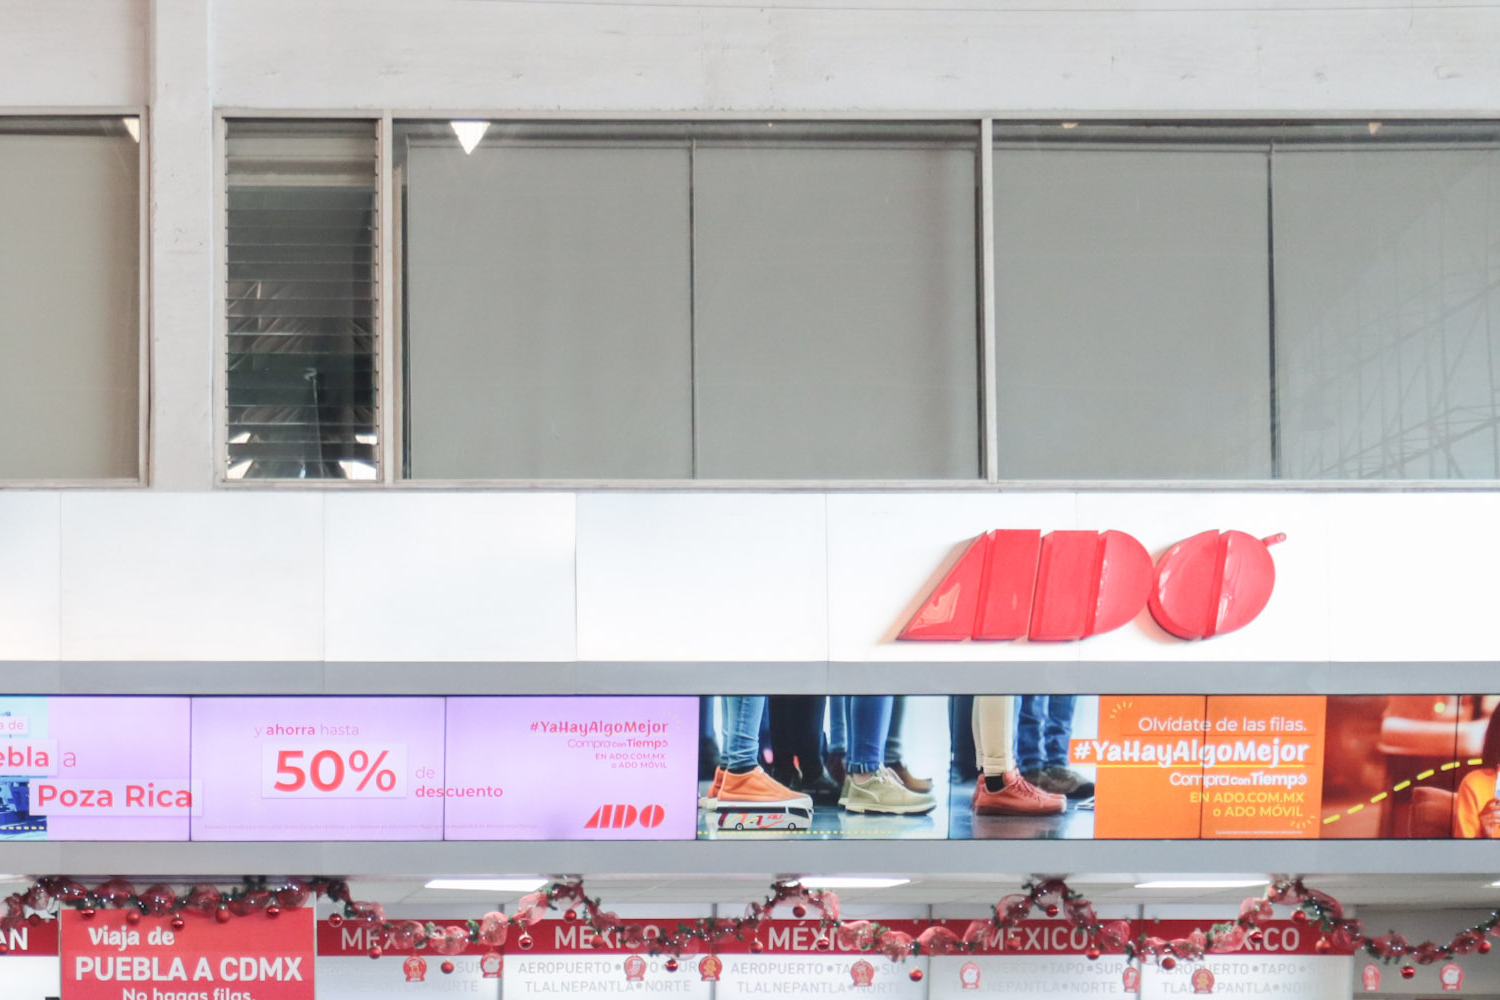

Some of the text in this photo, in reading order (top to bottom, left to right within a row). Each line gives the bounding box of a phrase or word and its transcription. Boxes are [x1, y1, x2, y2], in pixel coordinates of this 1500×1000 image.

[896, 529, 1276, 641] ADO
[9, 719, 24, 731] de
[255, 724, 360, 738] y ahorra hasta
[530, 720, 668, 738] #YaHayAlgoMejor
[1138, 716, 1307, 732] Olvídate de las filas.
[63, 752, 76, 767] a
[1073, 738, 1309, 768] #YaHayAlgoMejor
[274, 750, 396, 793] 50%
[415, 766, 436, 780] de
[38, 782, 193, 807] Poza Rica
[415, 785, 503, 799] descuento
[1190, 792, 1304, 803] EN ADO.COM.MX
[583, 804, 665, 829] ADO
[1224, 807, 1257, 818] ADO
[1260, 804, 1304, 818] MÓVIL
[88, 925, 175, 951] Viaja de
[75, 956, 188, 981] PUEBLA
[193, 956, 213, 981] A
[220, 956, 303, 981] CDMX
[518, 962, 611, 974] AEROPUERTO
[731, 963, 824, 975] AEROPUERTO
[645, 980, 692, 993] NORTE
